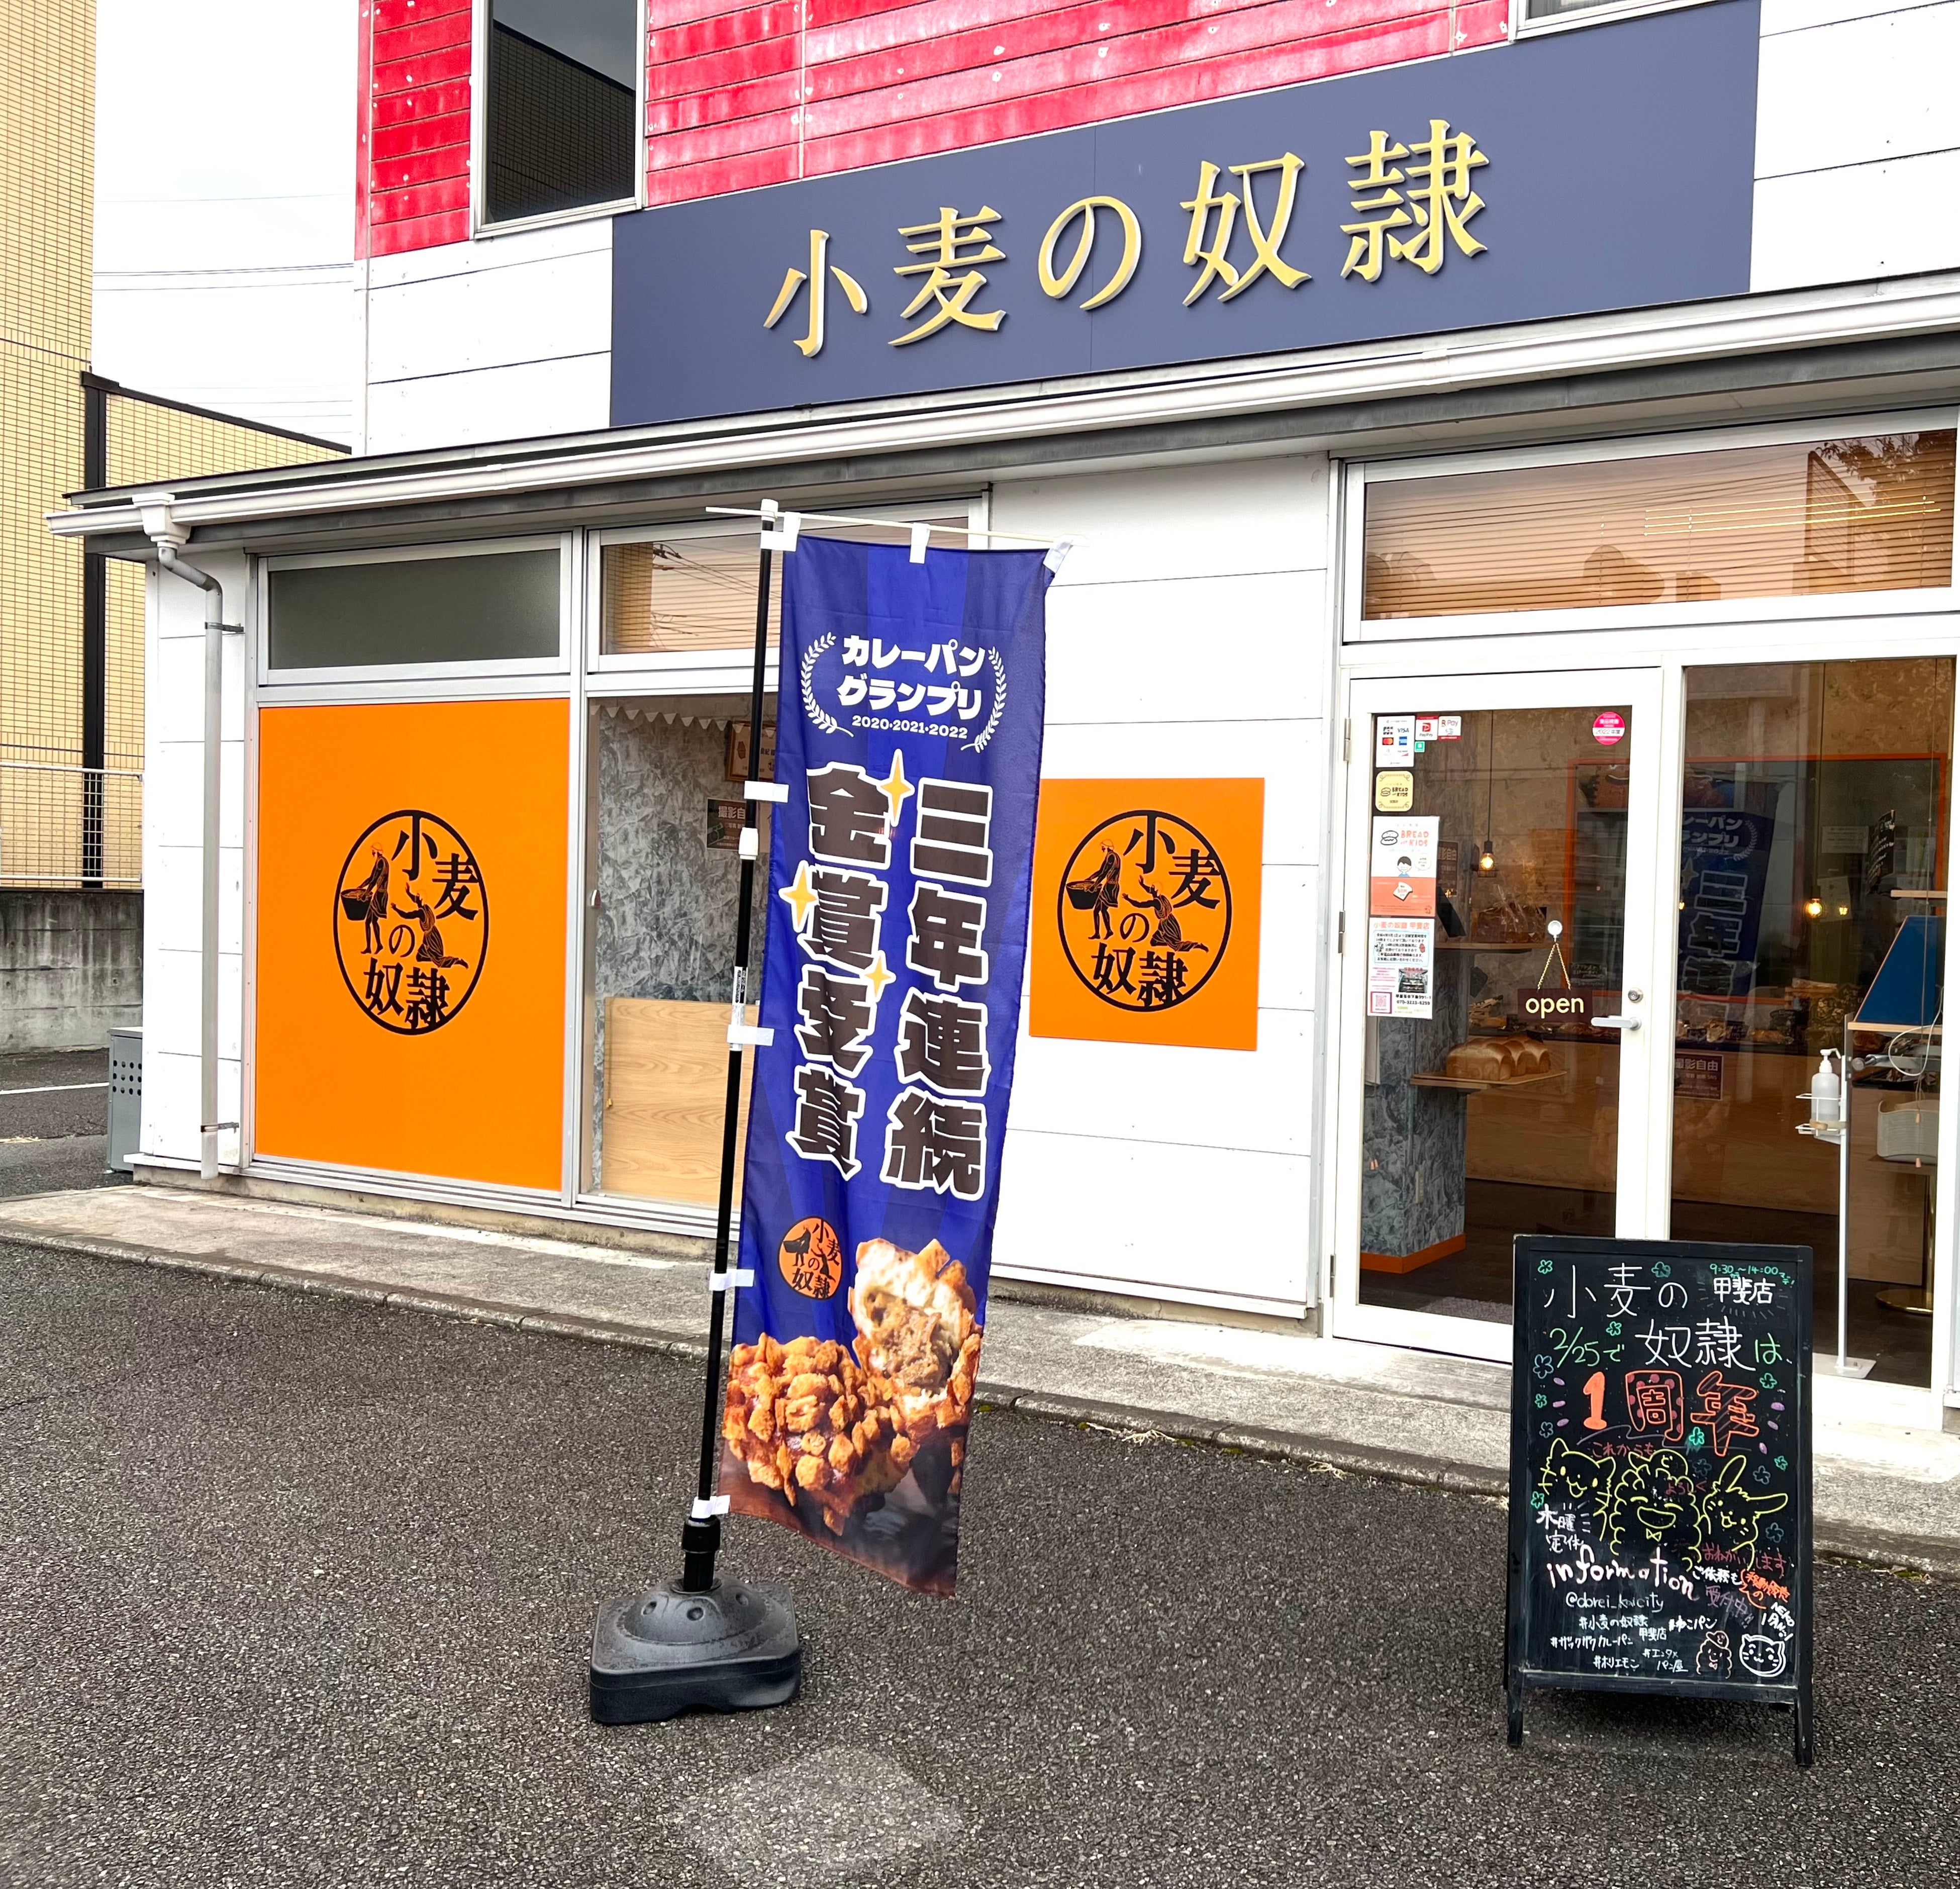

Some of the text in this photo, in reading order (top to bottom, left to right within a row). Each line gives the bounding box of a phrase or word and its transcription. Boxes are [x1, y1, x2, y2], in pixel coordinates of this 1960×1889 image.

[764, 119, 1489, 357] 小麦の奴隷
[842, 635, 986, 677] カレーパン
[836, 673, 982, 720] グランプリ
[718, 805, 746, 820] 撮影自
[1401, 830, 1429, 838] BREAD
[785, 761, 892, 1182] 金賞受賞
[880, 777, 993, 1202] 三年連続
[1525, 995, 1584, 1018] open
[1544, 1262, 1688, 1318] 小麦の
[1713, 1277, 1776, 1305] 甲斐店
[1583, 1370, 1759, 1457] 1周年
[1592, 1442, 1654, 1458] これからも
[1665, 1480, 1707, 1495] よろしく
[1536, 1503, 1576, 1531] 木曜
[1545, 1530, 1584, 1553] 定休
[1546, 1544, 1700, 1601] information
